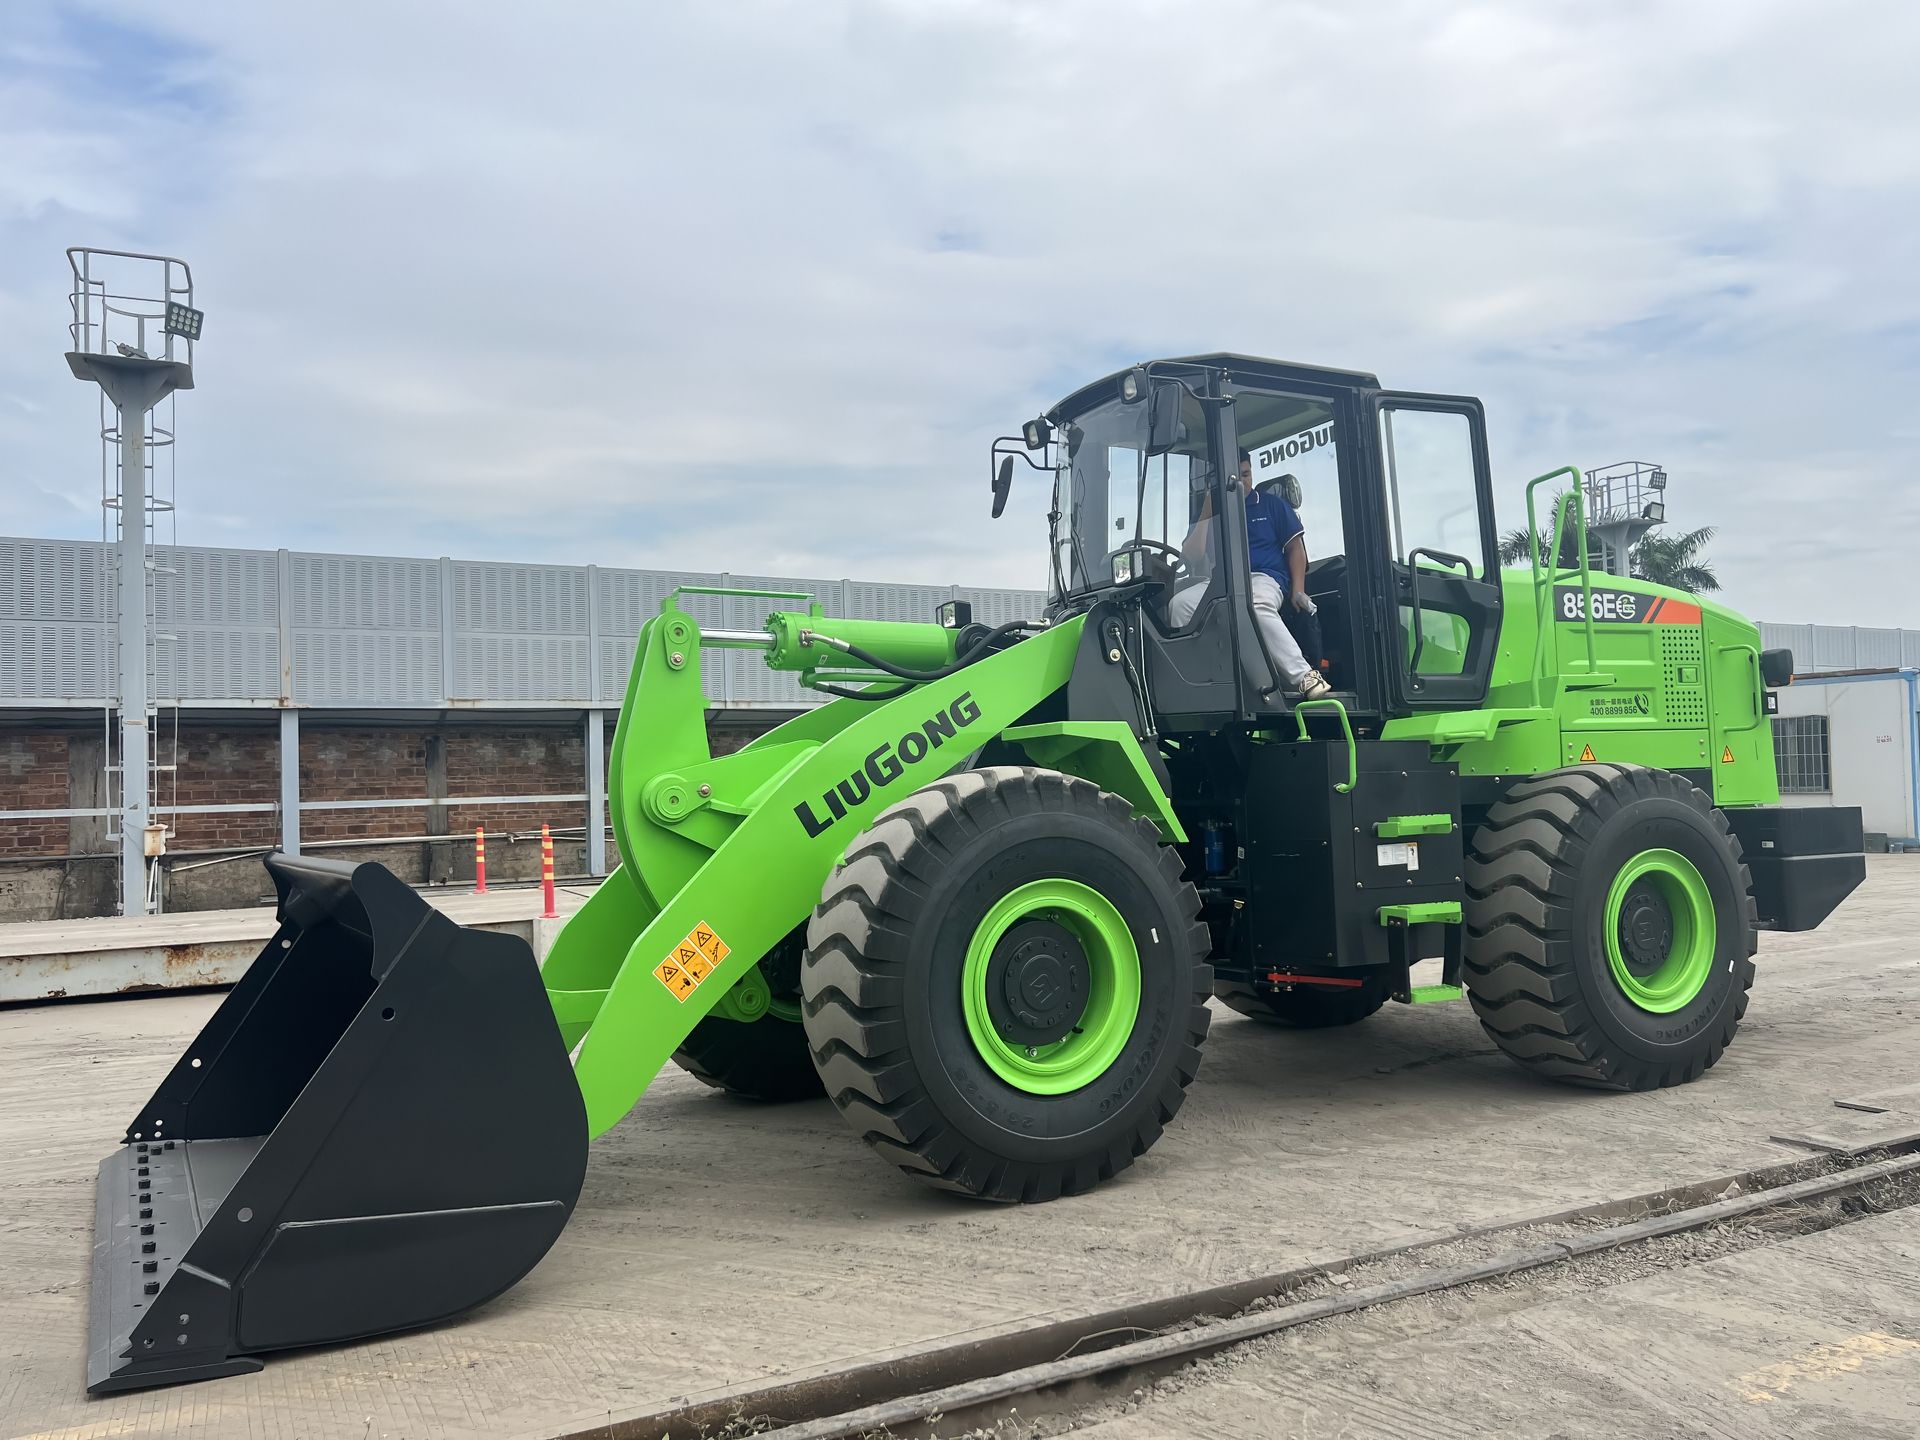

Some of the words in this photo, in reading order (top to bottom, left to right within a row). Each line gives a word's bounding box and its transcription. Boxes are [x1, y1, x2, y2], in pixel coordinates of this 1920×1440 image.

[1590, 707, 1604, 715] 400
[1605, 706, 1623, 715] 8899
[1624, 705, 1638, 714] 856
[793, 690, 982, 839] LIUGONG
